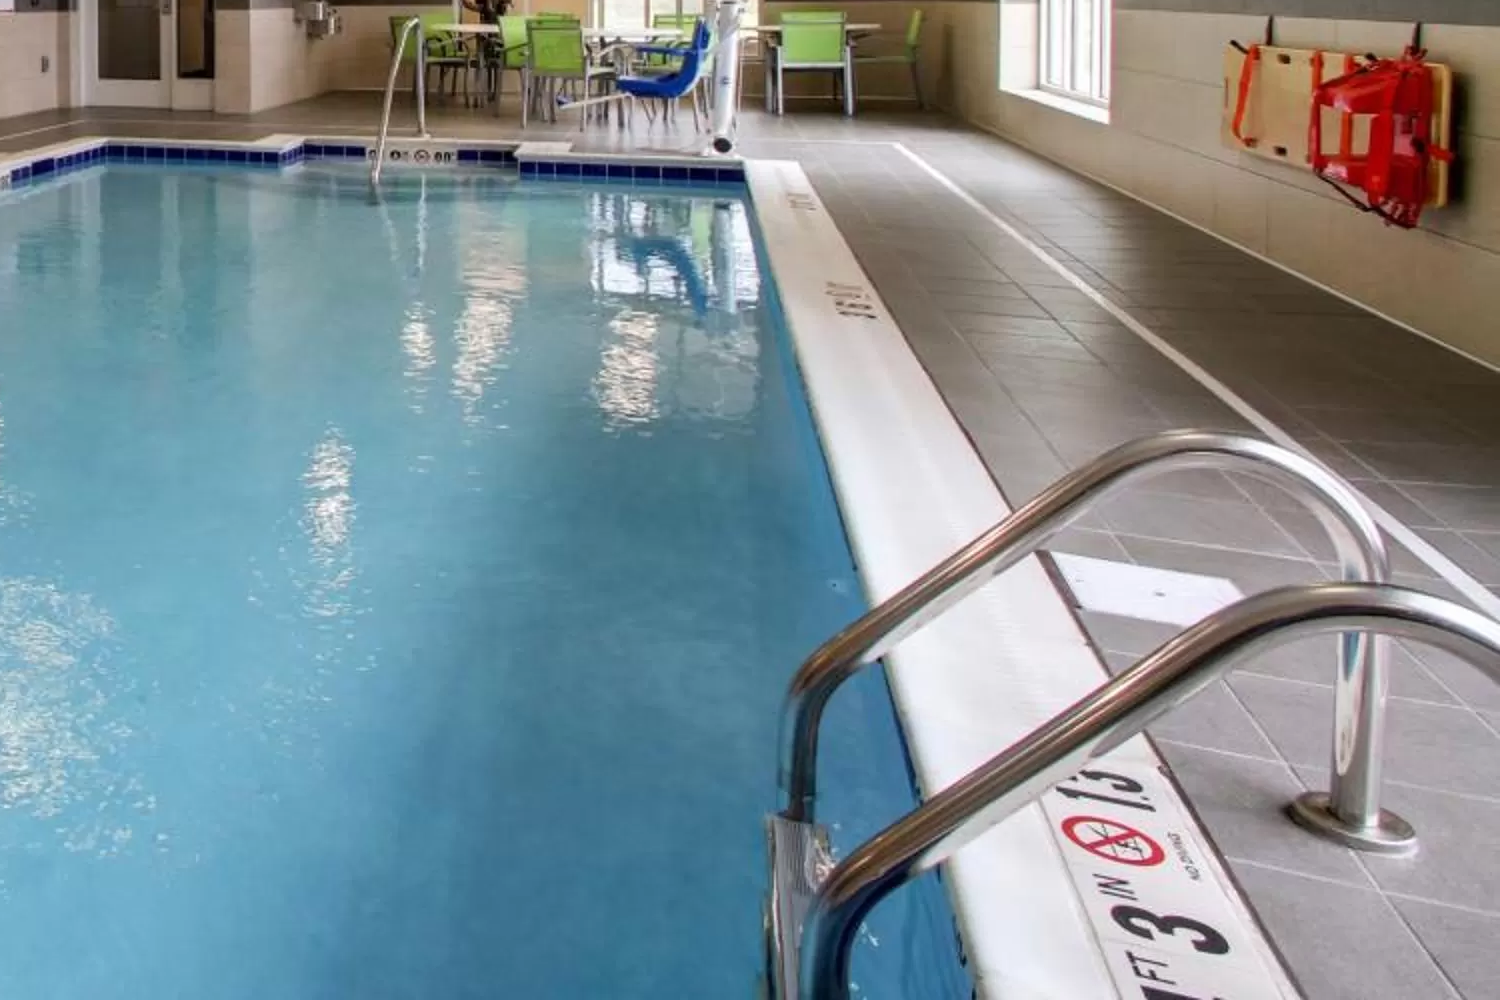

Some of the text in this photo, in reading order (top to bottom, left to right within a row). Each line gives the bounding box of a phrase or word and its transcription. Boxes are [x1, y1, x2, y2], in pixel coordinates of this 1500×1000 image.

[1093, 872, 1139, 901] IN
[1111, 904, 1230, 956] 3
[1125, 950, 1177, 986] FT
